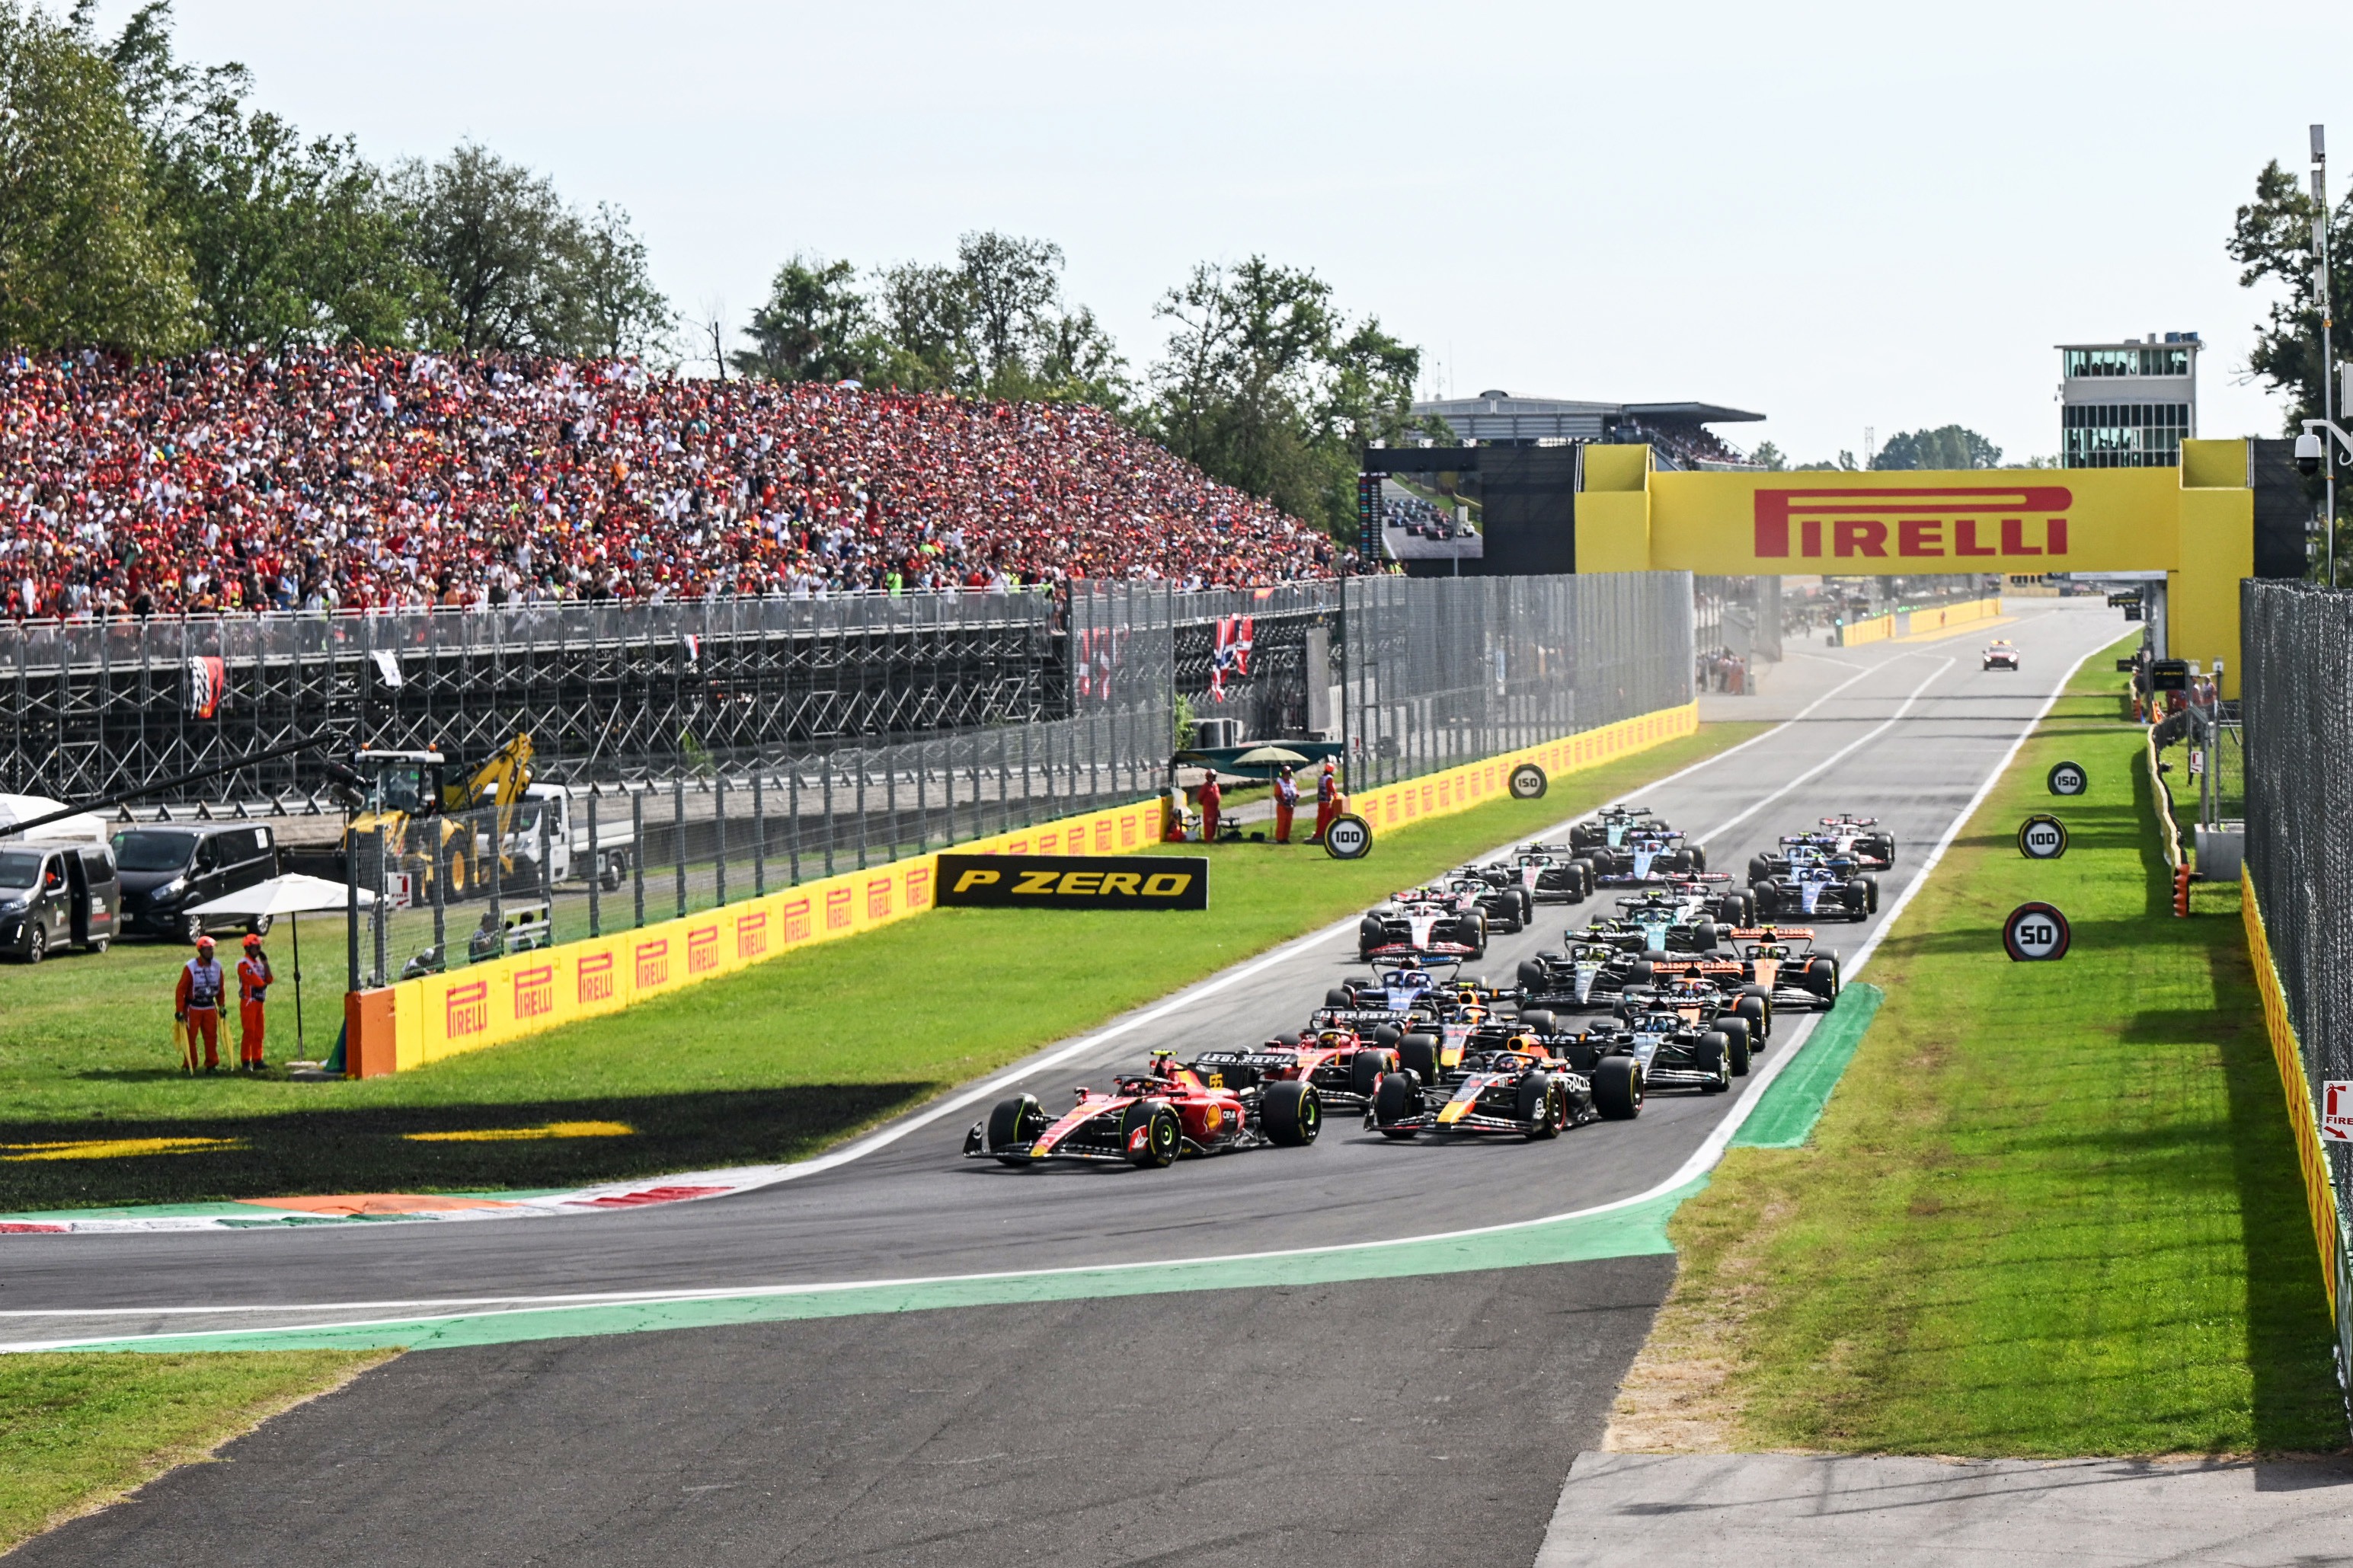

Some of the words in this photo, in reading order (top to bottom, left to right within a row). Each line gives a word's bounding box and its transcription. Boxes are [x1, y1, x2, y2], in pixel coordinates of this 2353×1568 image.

[1754, 486, 2073, 557] PIRELLI
[1518, 777, 1537, 787] 150
[2057, 776, 2077, 786] 150
[1336, 831, 1360, 843] 100
[2030, 832, 2056, 845] 100
[868, 877, 892, 919] PIRELLI
[953, 870, 1000, 893] P
[1011, 871, 1192, 896] ZERO
[784, 898, 810, 944] PIRELLI
[826, 887, 852, 930] PIRELLI
[688, 925, 718, 974] PIRELLI
[737, 912, 766, 959] PIRELLI
[2020, 925, 2052, 944] 50
[577, 951, 613, 1004] PIRELLI
[635, 939, 668, 989] PIRELLI
[446, 980, 488, 1039] PIRELLI
[513, 965, 553, 1020] PIRELLI
[1209, 1073, 1223, 1091] 55
[2326, 1116, 2353, 1125] FIRE
